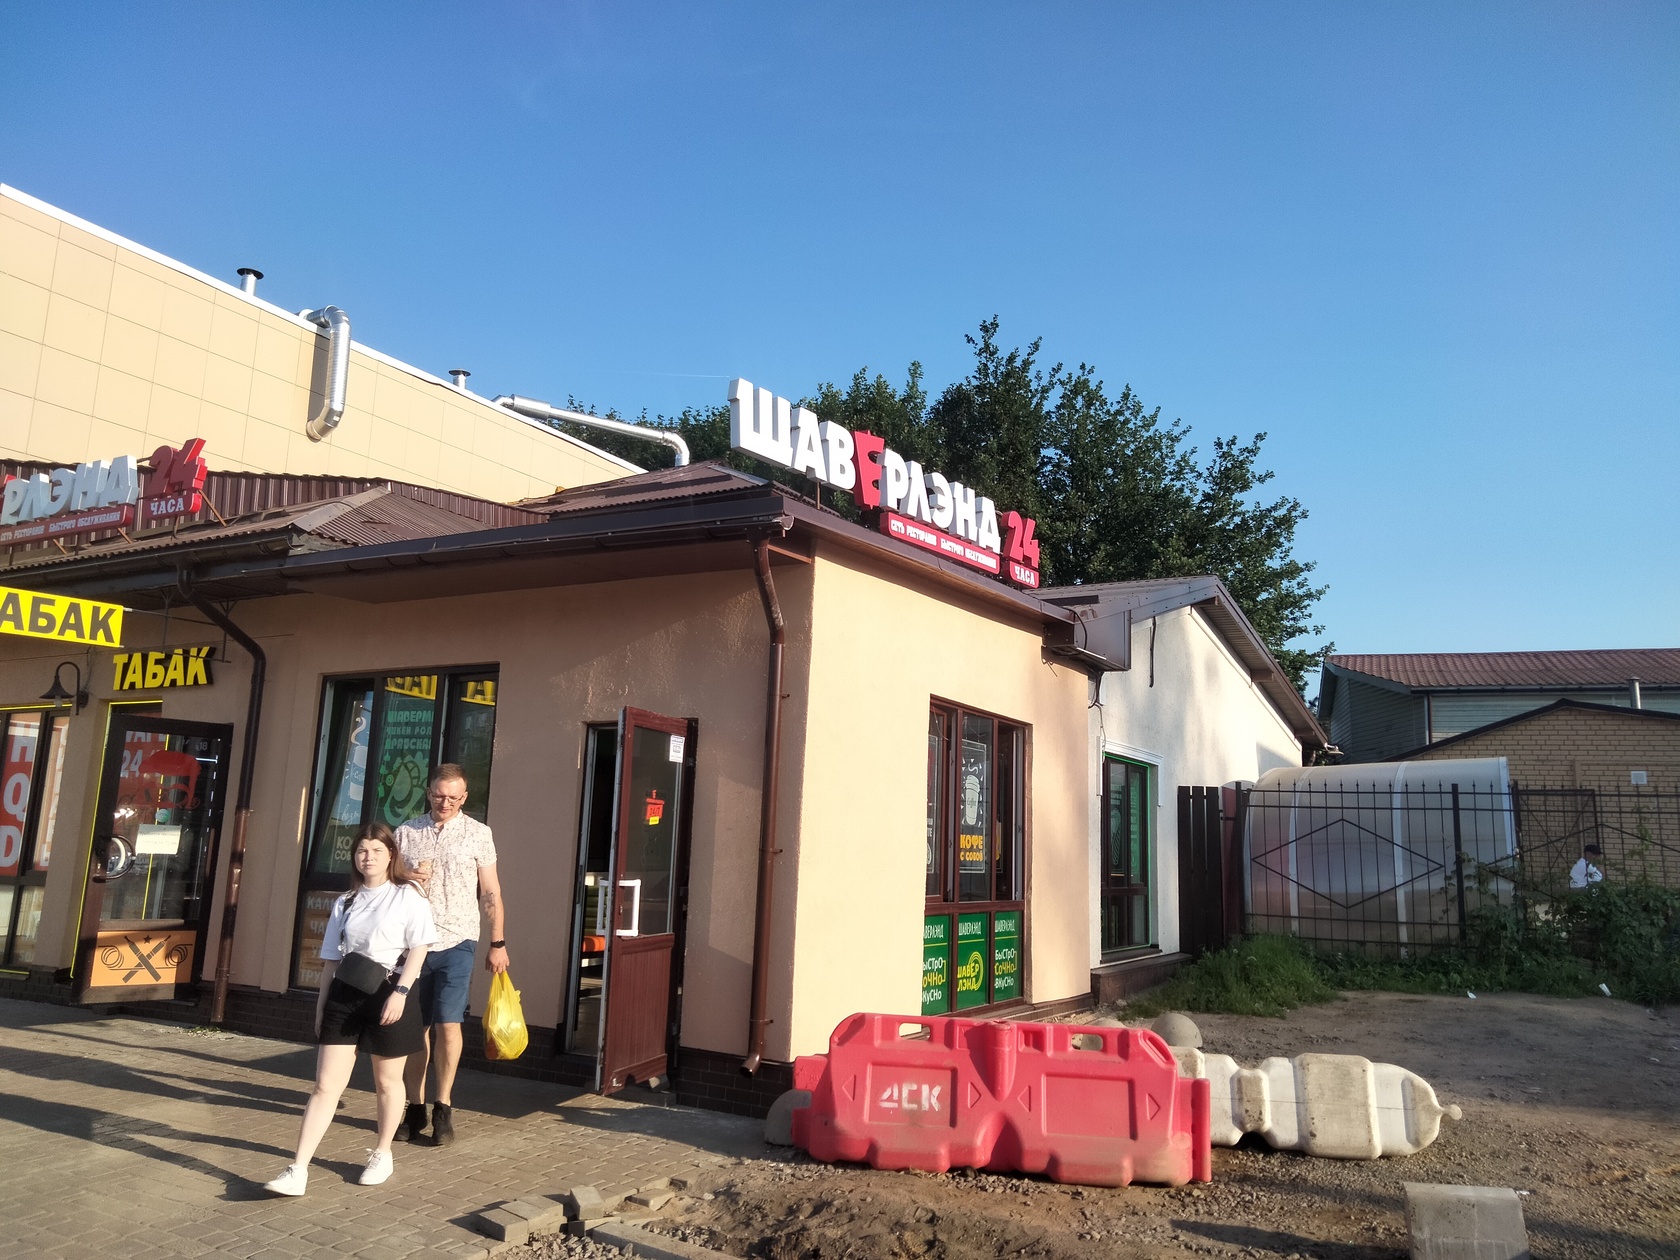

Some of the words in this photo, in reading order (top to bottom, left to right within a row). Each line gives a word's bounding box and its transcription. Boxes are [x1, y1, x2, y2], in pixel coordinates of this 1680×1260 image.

[149, 438, 208, 498] 24
[728, 378, 1001, 554] ШАВЕРЛЭНД
[1002, 511, 1040, 568] 24
[151, 497, 184, 516] ЧАСА
[1014, 566, 1035, 586] ЧАСА
[113, 647, 211, 691] ТАБАК
[960, 834, 984, 849] КОФЕ
[958, 922, 982, 935] ШАВЕРЛЭНД
[995, 920, 1015, 932] ШАВЕРЛЭНД
